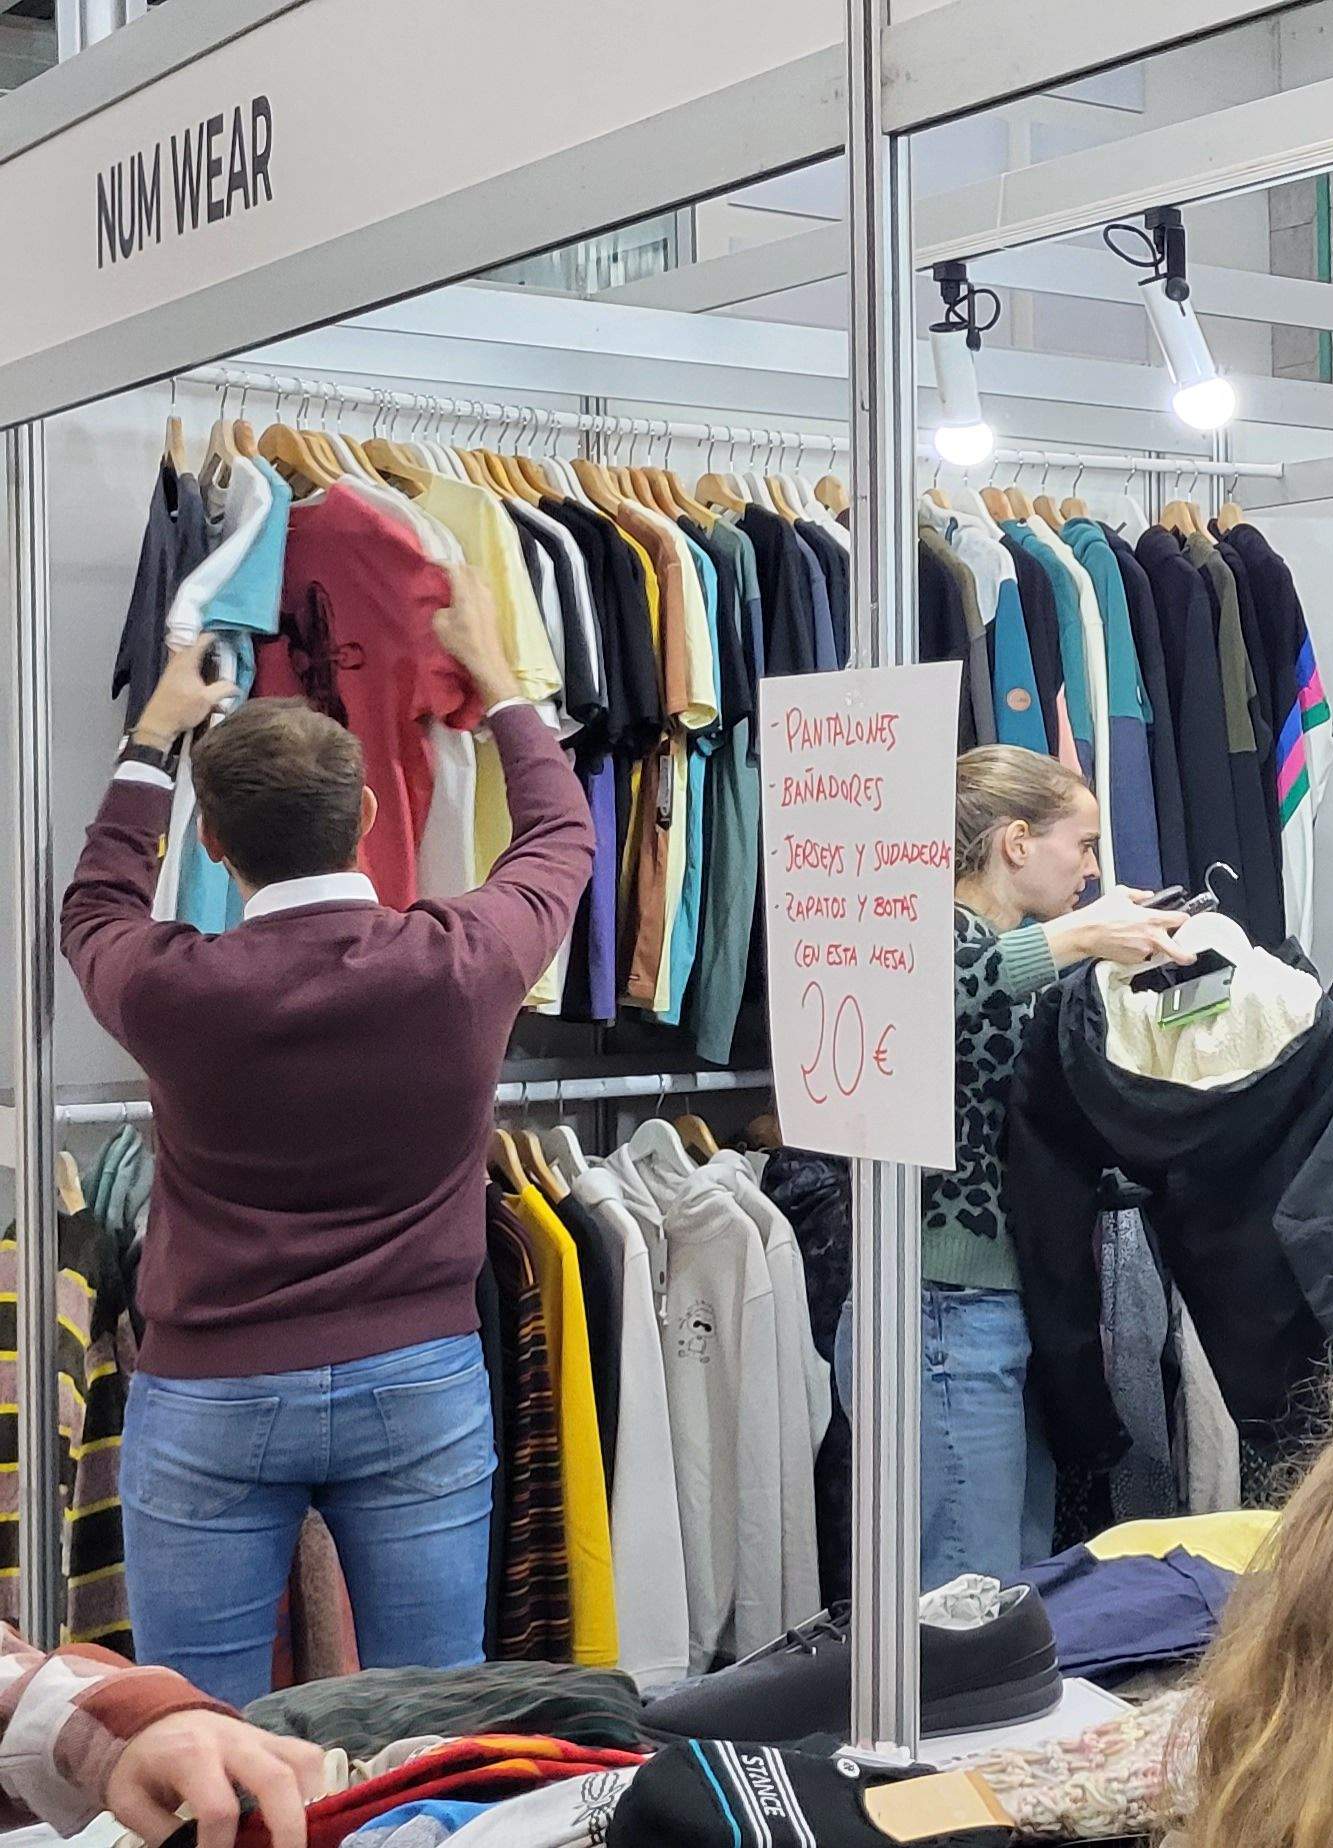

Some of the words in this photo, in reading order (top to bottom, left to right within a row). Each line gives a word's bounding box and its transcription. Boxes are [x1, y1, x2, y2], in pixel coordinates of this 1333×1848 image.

[97, 172, 161, 269] NUM
[170, 95, 272, 236] WEAR
[785, 706, 899, 753] PANTALONES
[781, 767, 883, 812] BAÑADORES
[784, 835, 845, 876] JERSEYS
[855, 843, 865, 876] Y
[874, 840, 951, 871] SUDADERAS
[785, 892, 846, 922] ZAPATOS
[857, 893, 867, 922] Y
[873, 894, 918, 922] BOTAS
[794, 939, 820, 967] (EN
[827, 944, 857, 966] ESTA
[741, 1754, 786, 1818] STANCE
